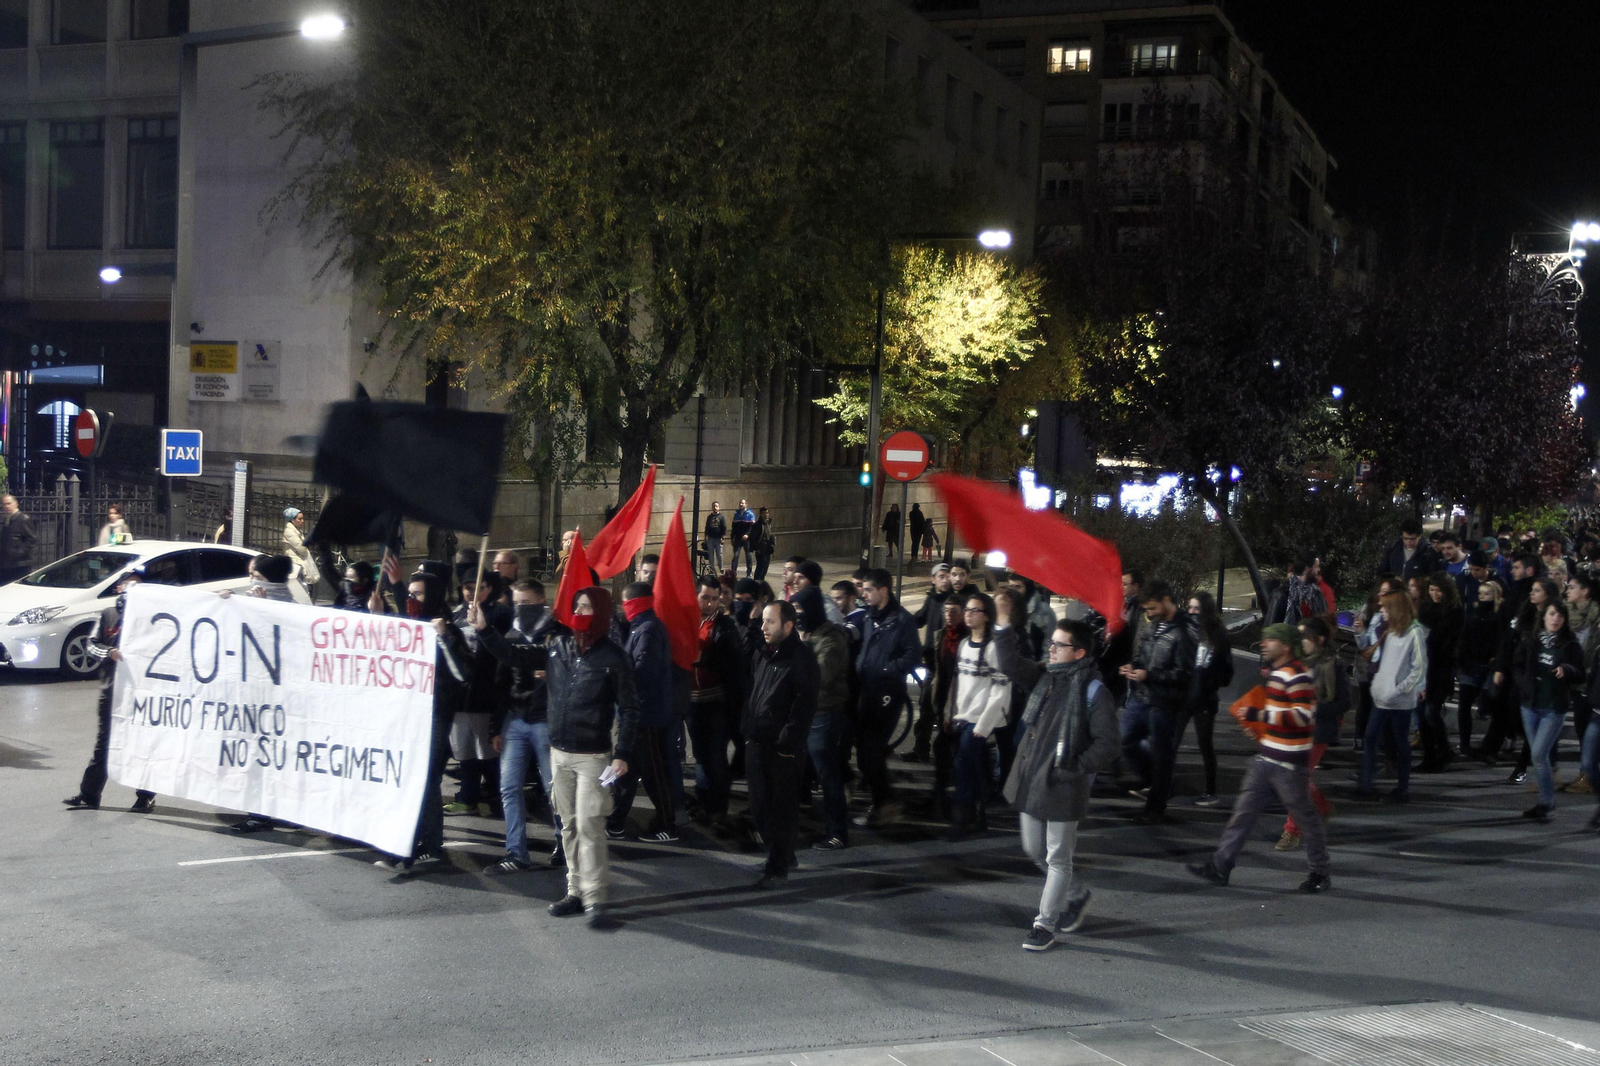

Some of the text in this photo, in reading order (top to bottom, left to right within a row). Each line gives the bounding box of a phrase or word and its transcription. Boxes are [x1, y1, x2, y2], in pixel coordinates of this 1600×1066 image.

[166, 446, 200, 461] TAXI
[145, 612, 281, 686] 20-N
[311, 616, 425, 655] GRANADA
[311, 651, 434, 695] ANTIFASCISTA
[131, 693, 286, 736] MURIÓ FRANCO
[882, 695, 891, 706] 9
[219, 735, 403, 788] NO SU RÉGIMEN
